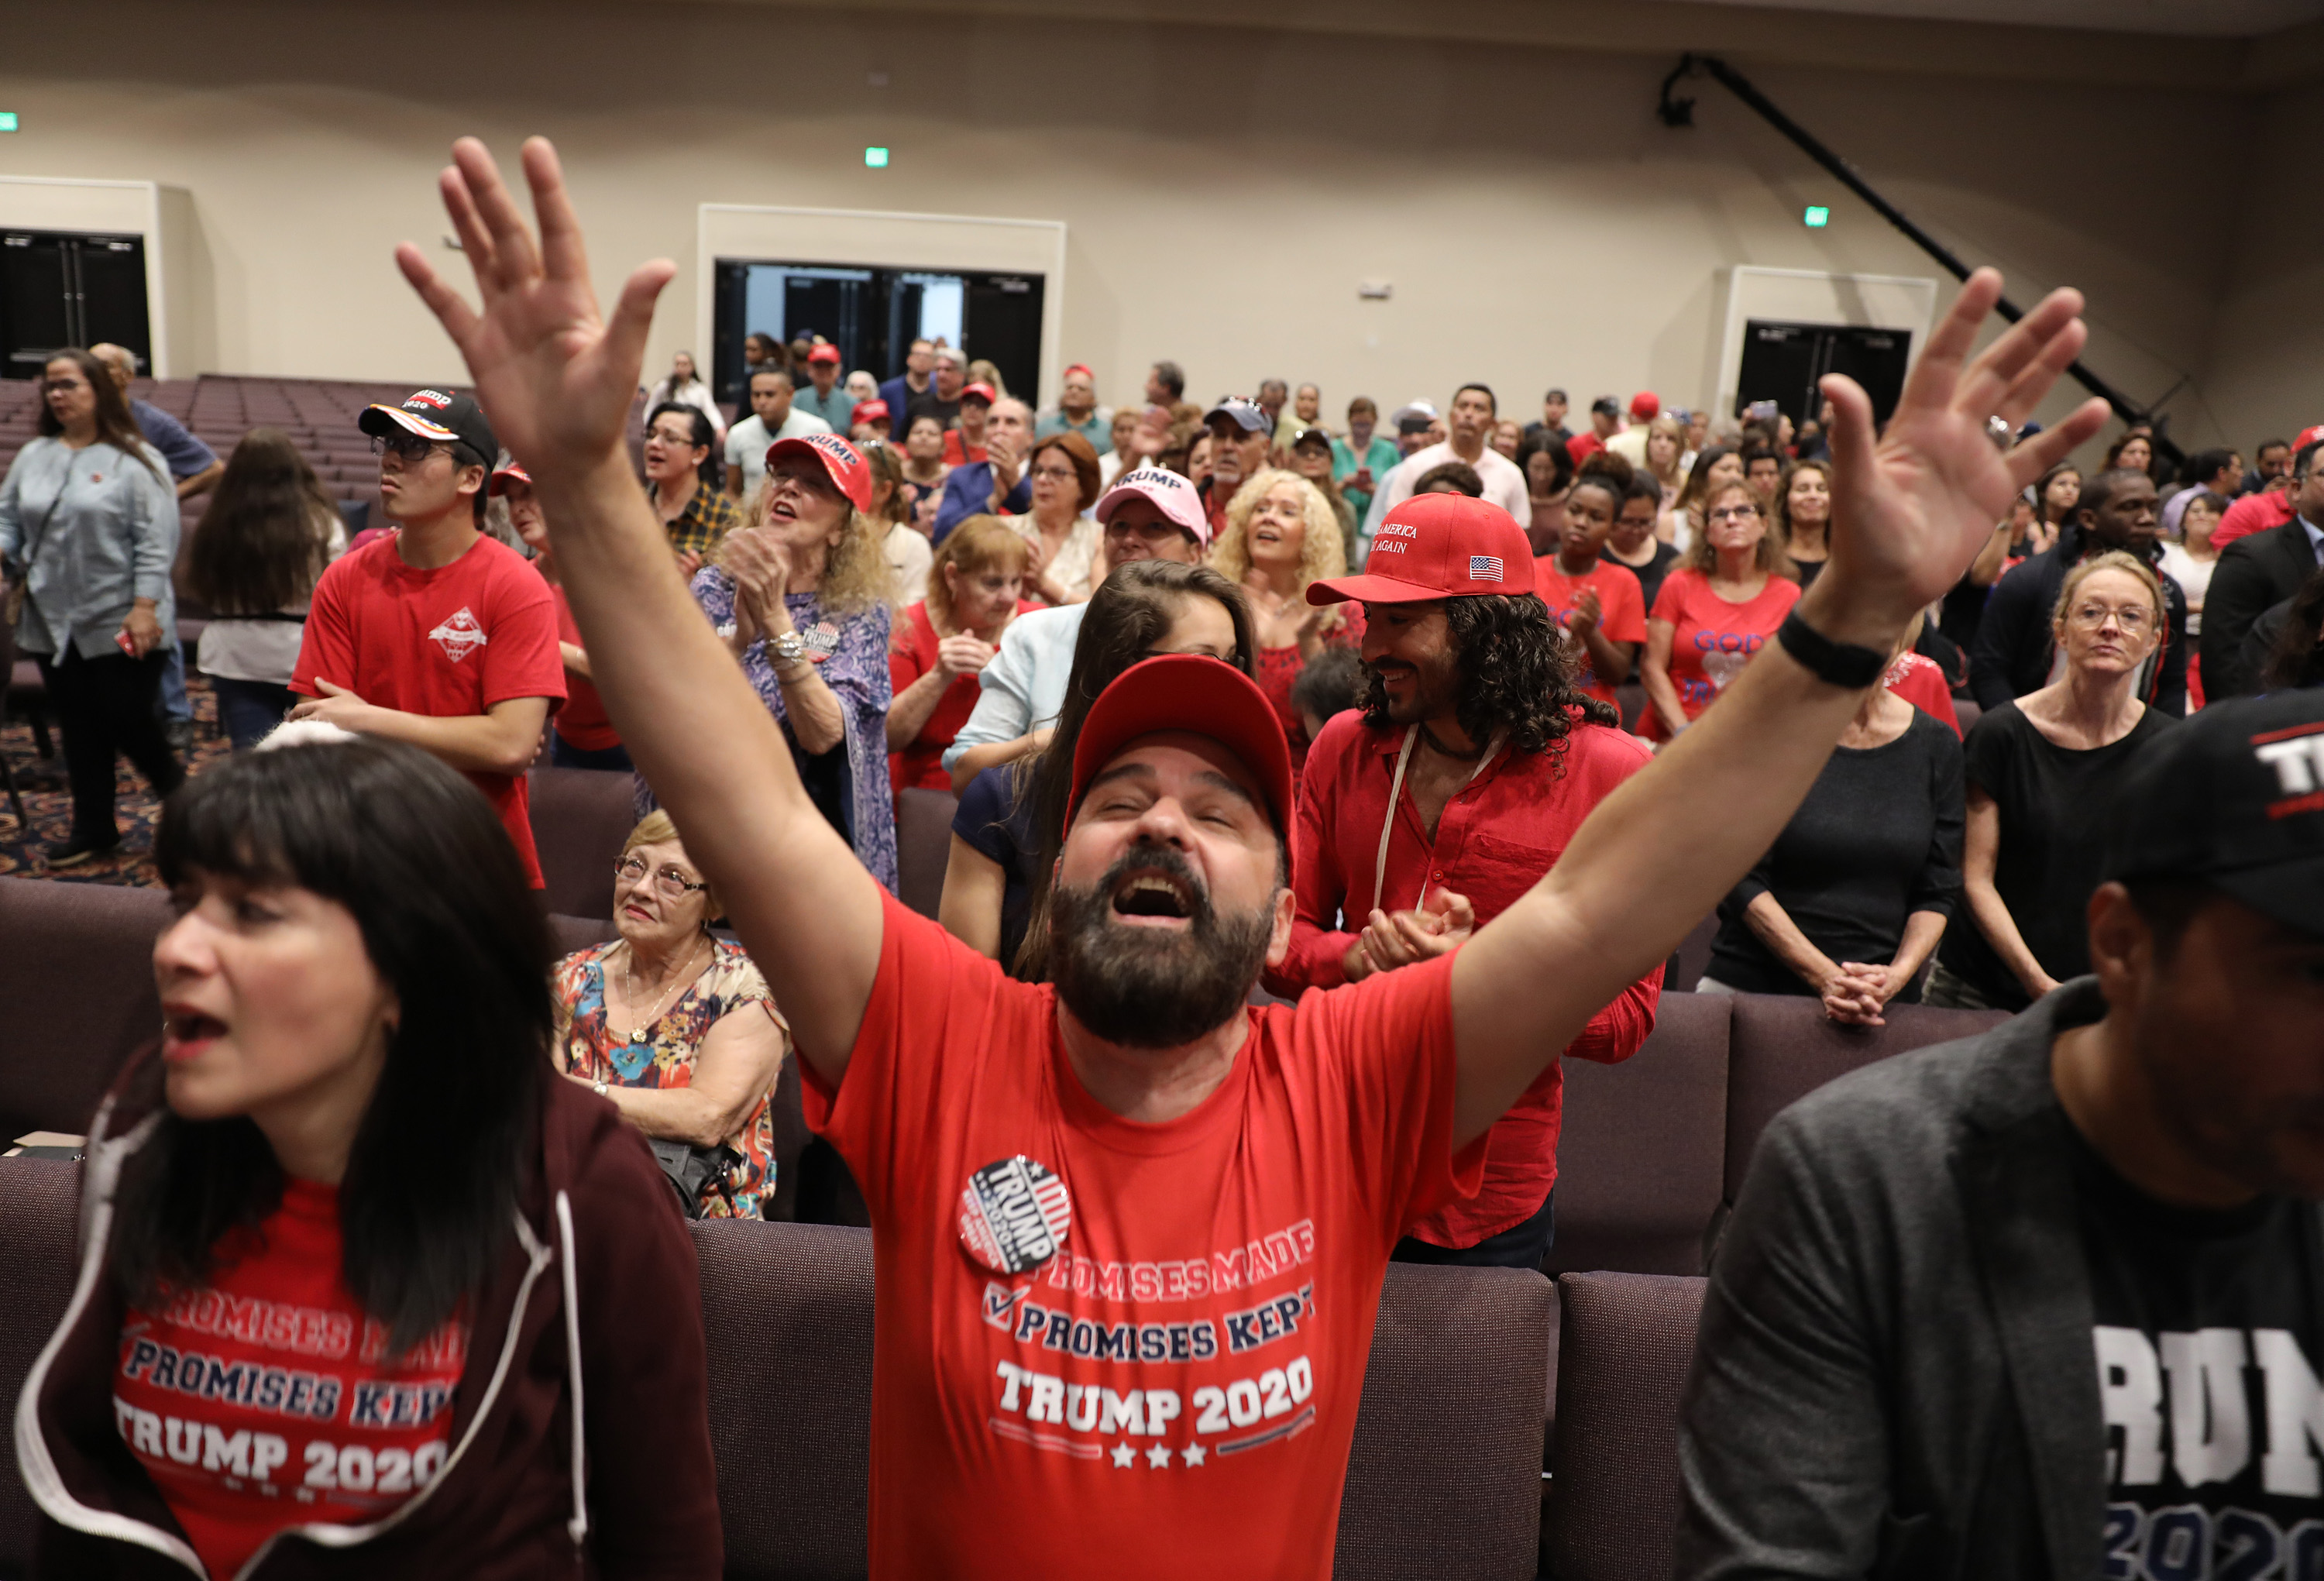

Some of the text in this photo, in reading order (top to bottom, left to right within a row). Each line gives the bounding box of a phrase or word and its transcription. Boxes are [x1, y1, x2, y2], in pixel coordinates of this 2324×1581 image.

[1116, 471, 1181, 489] TRUMP
[1376, 540, 1408, 555] AGAIN
[1378, 524, 1417, 539] AMERICA
[1694, 631, 1765, 654] GOD
[984, 1196, 1013, 1246] 2020
[988, 1159, 1053, 1260] TRUMP
[1212, 1218, 1315, 1294] MADE
[1015, 1301, 1219, 1363] PROMISES
[122, 1337, 341, 1421] PROMISES
[996, 1356, 1315, 1436] TRUMP 2020
[113, 1393, 448, 1494] TRUMP 2020
